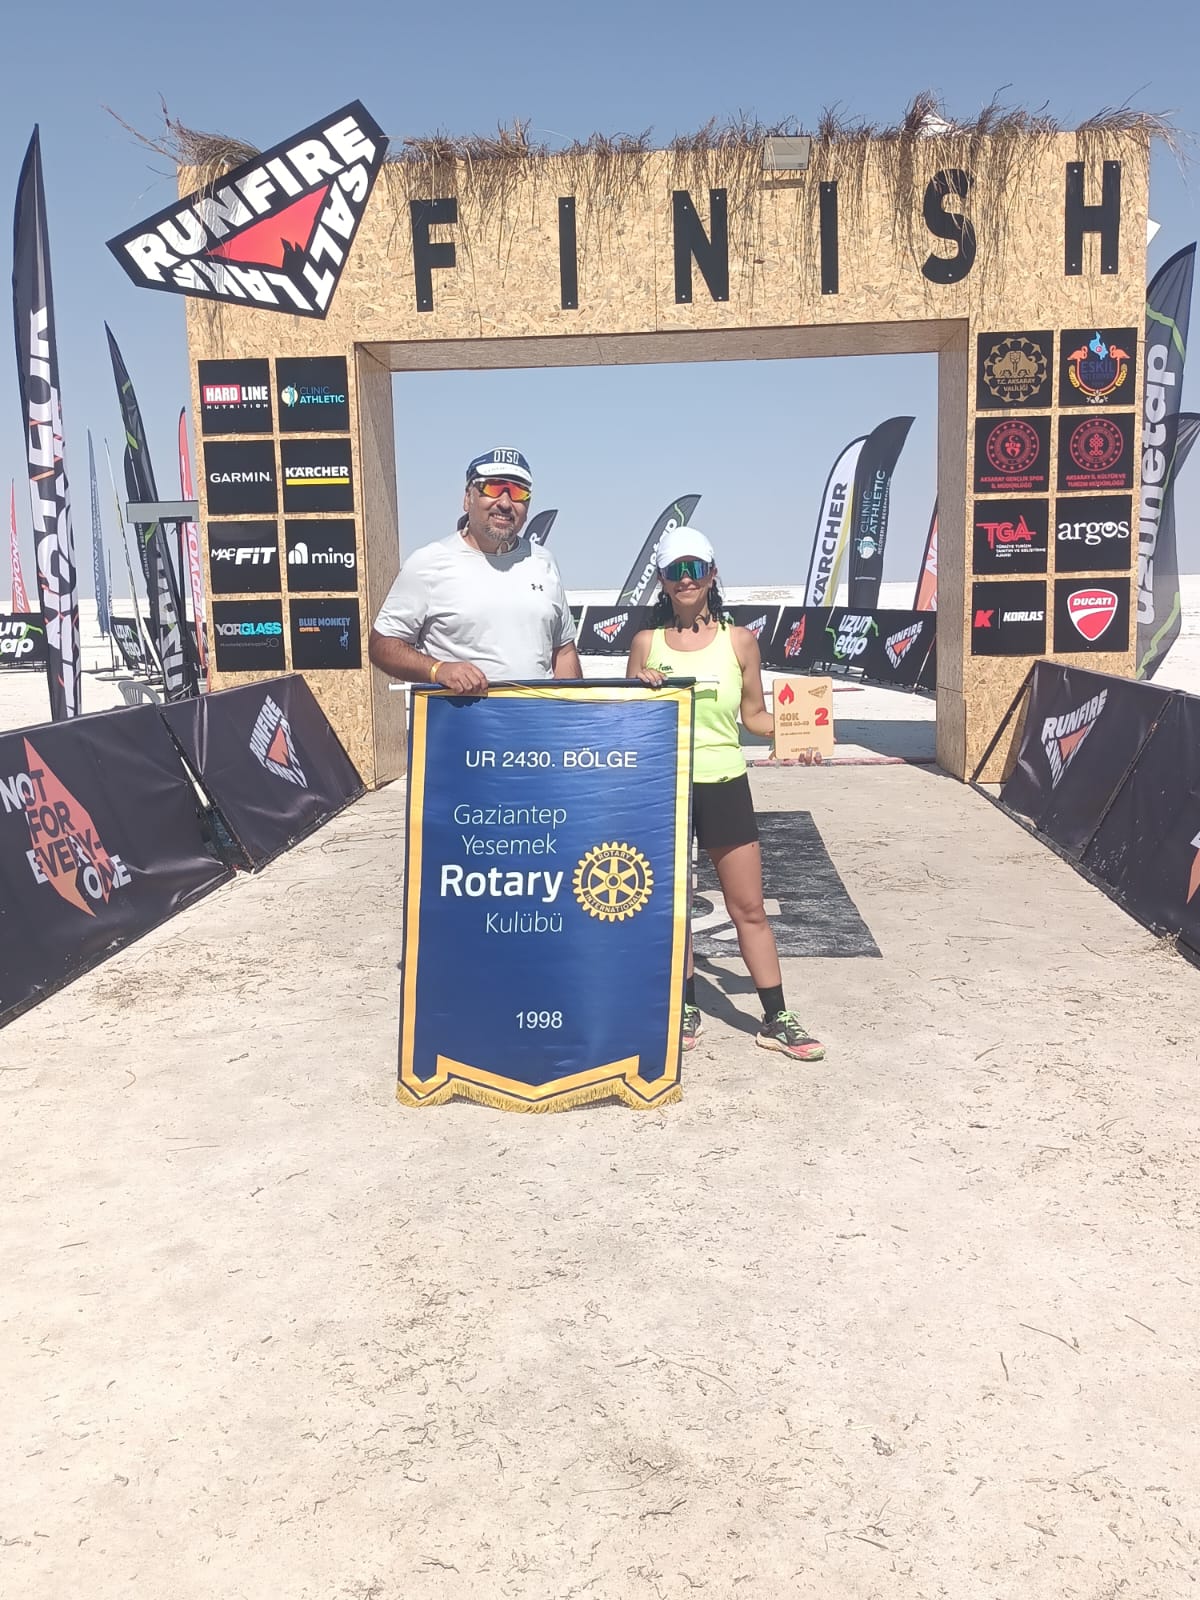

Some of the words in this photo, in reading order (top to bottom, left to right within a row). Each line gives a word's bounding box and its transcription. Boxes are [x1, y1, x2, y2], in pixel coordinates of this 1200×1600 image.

[124, 114, 376, 281] RUNFIRE
[301, 162, 370, 312] SALT
[410, 161, 1121, 312] FINISH
[206, 387, 238, 402] HARD
[242, 386, 268, 401] LINE
[300, 386, 330, 395] CLINIC
[300, 394, 345, 404] ATHLETIC
[210, 471, 273, 483] GARMIN
[285, 466, 349, 478] KÄRCHER
[861, 490, 872, 533] CLINIC
[870, 470, 886, 535] ATHLETIC
[976, 515, 1037, 549] TGA
[1058, 521, 1129, 545] argos
[311, 547, 355, 568] ming
[1072, 598, 1112, 606] DUCATI
[299, 618, 317, 626] BLUE
[318, 617, 351, 626] MONKEY
[594, 612, 628, 632] RUNFIRE
[838, 614, 872, 633] uzun
[1003, 611, 1044, 622] KORLAS
[215, 622, 282, 636] YORGLASS
[885, 621, 923, 650] RUNFIRE
[815, 707, 829, 726] 2
[1041, 688, 1108, 745] RUNFIRE
[250, 694, 286, 769] RUNFIRE
[466, 750, 495, 768] UR
[502, 750, 555, 768] 2430.
[563, 746, 638, 768] BÖLGE
[25, 801, 75, 844] FOR
[453, 803, 567, 829] Gaziantep
[462, 834, 557, 856] Yesemek
[598, 850, 632, 859] ROTARY
[83, 855, 132, 899] ONE
[440, 864, 565, 904] Rotary
[584, 892, 642, 913] INTERNATIONAL
[485, 911, 564, 934] Kulübü
[515, 1011, 563, 1030] 1998
